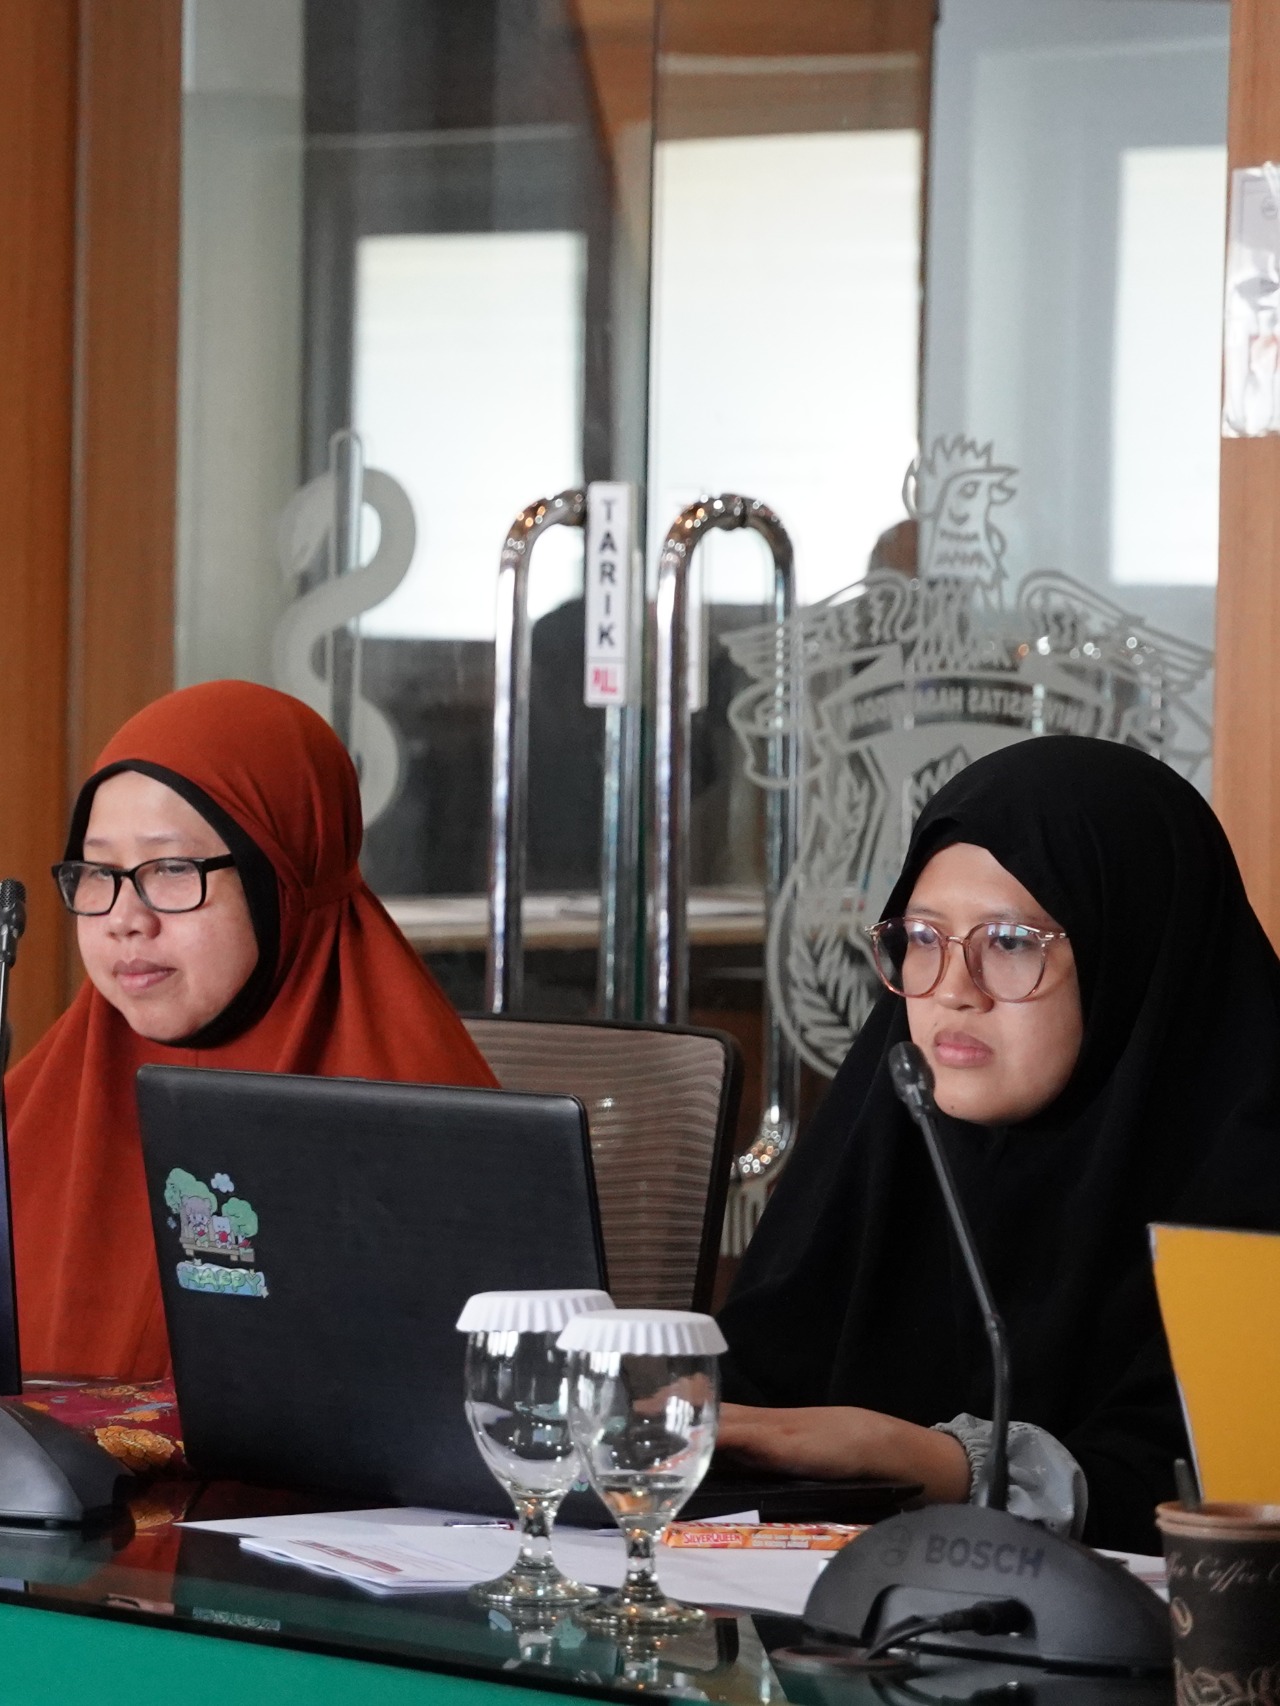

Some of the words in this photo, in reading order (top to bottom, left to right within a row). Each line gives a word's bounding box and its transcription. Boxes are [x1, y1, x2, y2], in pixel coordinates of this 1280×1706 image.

[597, 499, 618, 648] TARIK
[180, 1265, 262, 1296] HAPPY
[925, 1533, 1046, 1579] BOSCH
